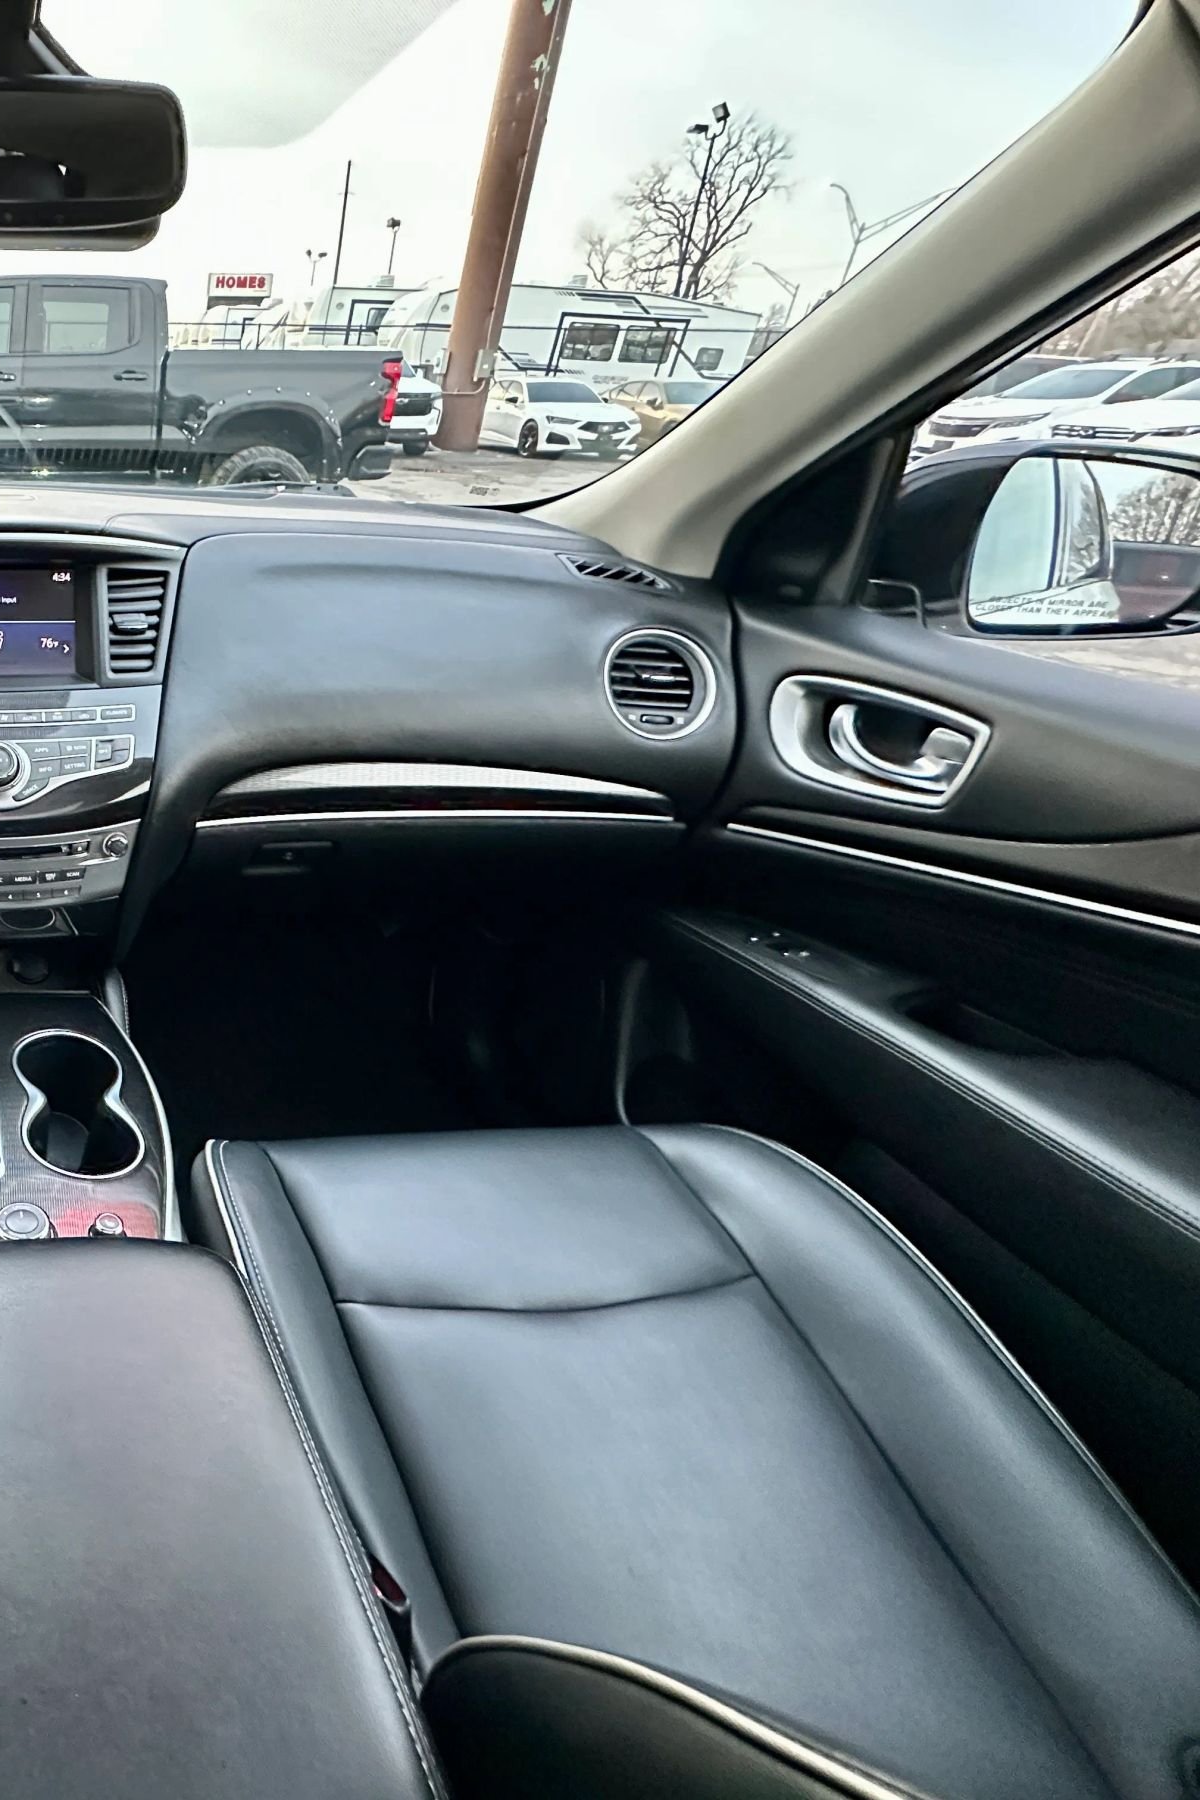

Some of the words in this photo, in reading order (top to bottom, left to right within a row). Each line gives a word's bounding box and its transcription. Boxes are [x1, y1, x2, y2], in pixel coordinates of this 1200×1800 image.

[215, 276, 266, 288] HOMES
[52, 572, 71, 582] 4:34
[1, 596, 17, 604] input
[1049, 599, 1085, 607] MIRROR
[1087, 600, 1109, 608] ARE
[1016, 605, 1041, 613] THAN
[1045, 606, 1069, 615] THEY
